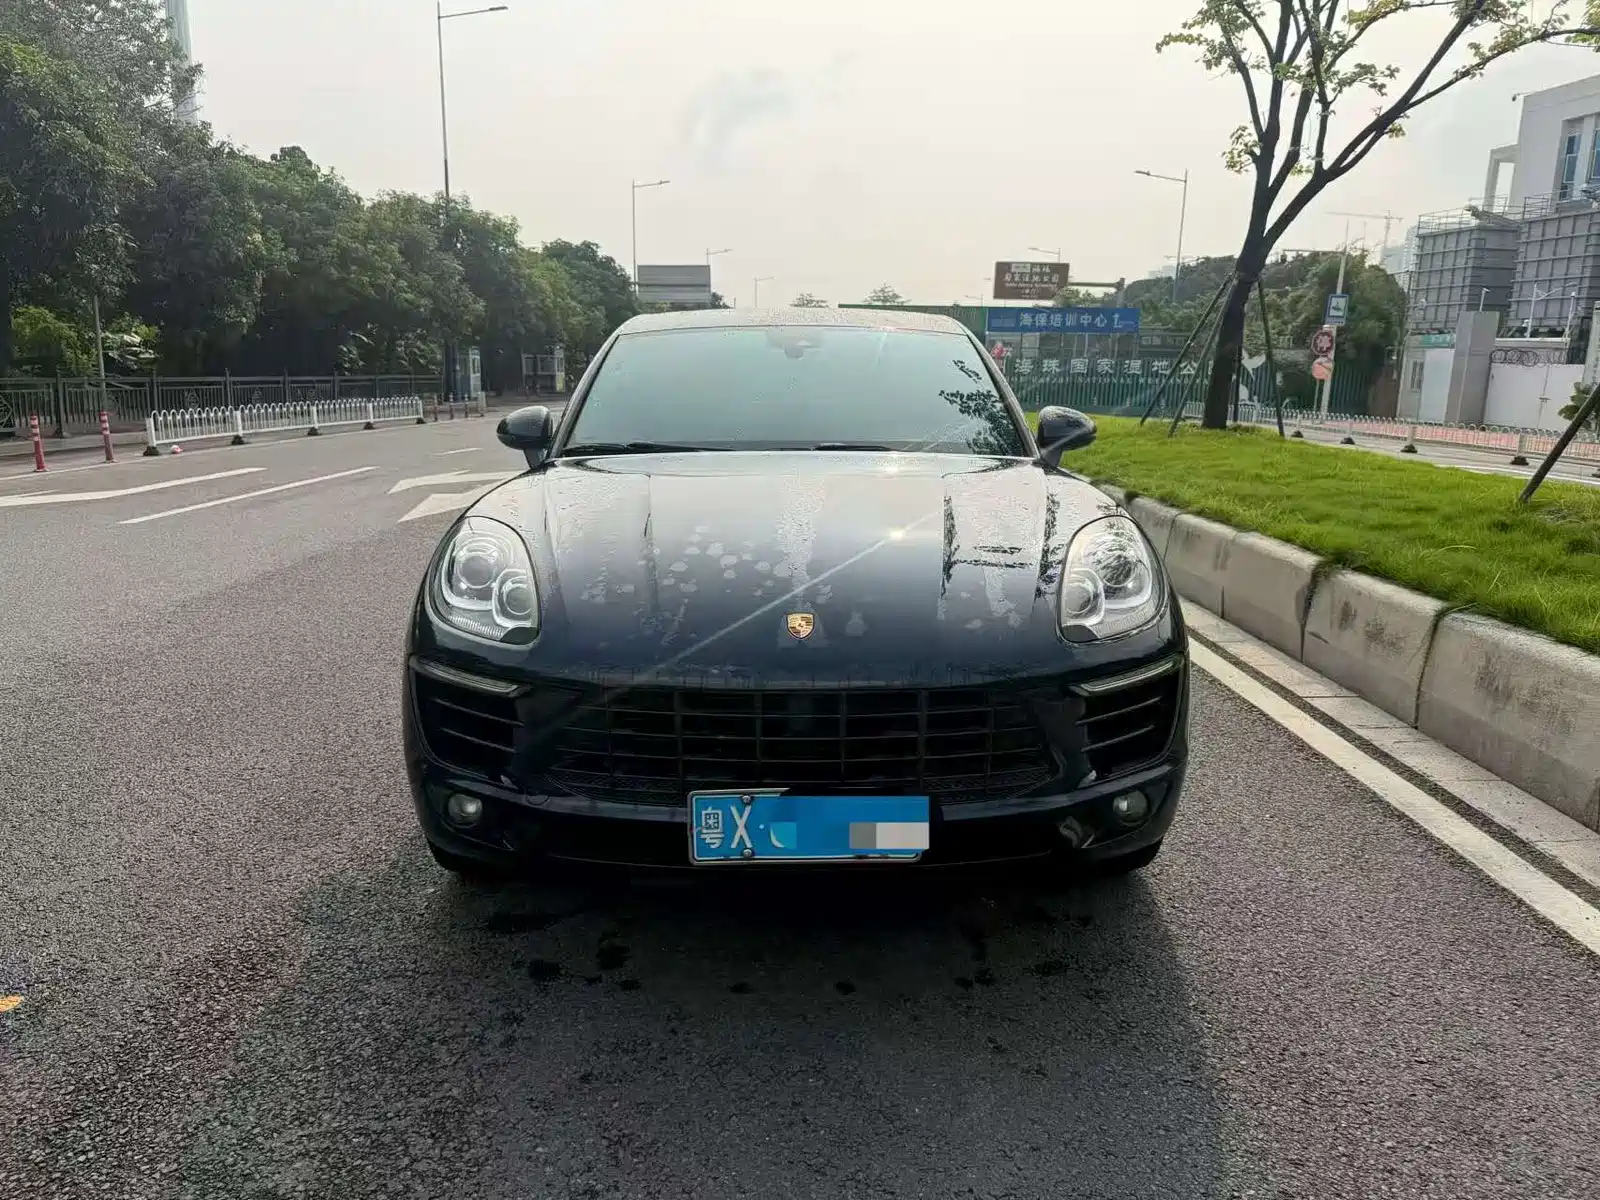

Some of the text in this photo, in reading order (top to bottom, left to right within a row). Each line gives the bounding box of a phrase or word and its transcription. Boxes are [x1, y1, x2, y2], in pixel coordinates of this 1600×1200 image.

[1020, 312, 1108, 328] 海保培训中心
[1014, 358, 1214, 375] 海珠国家湿地公
